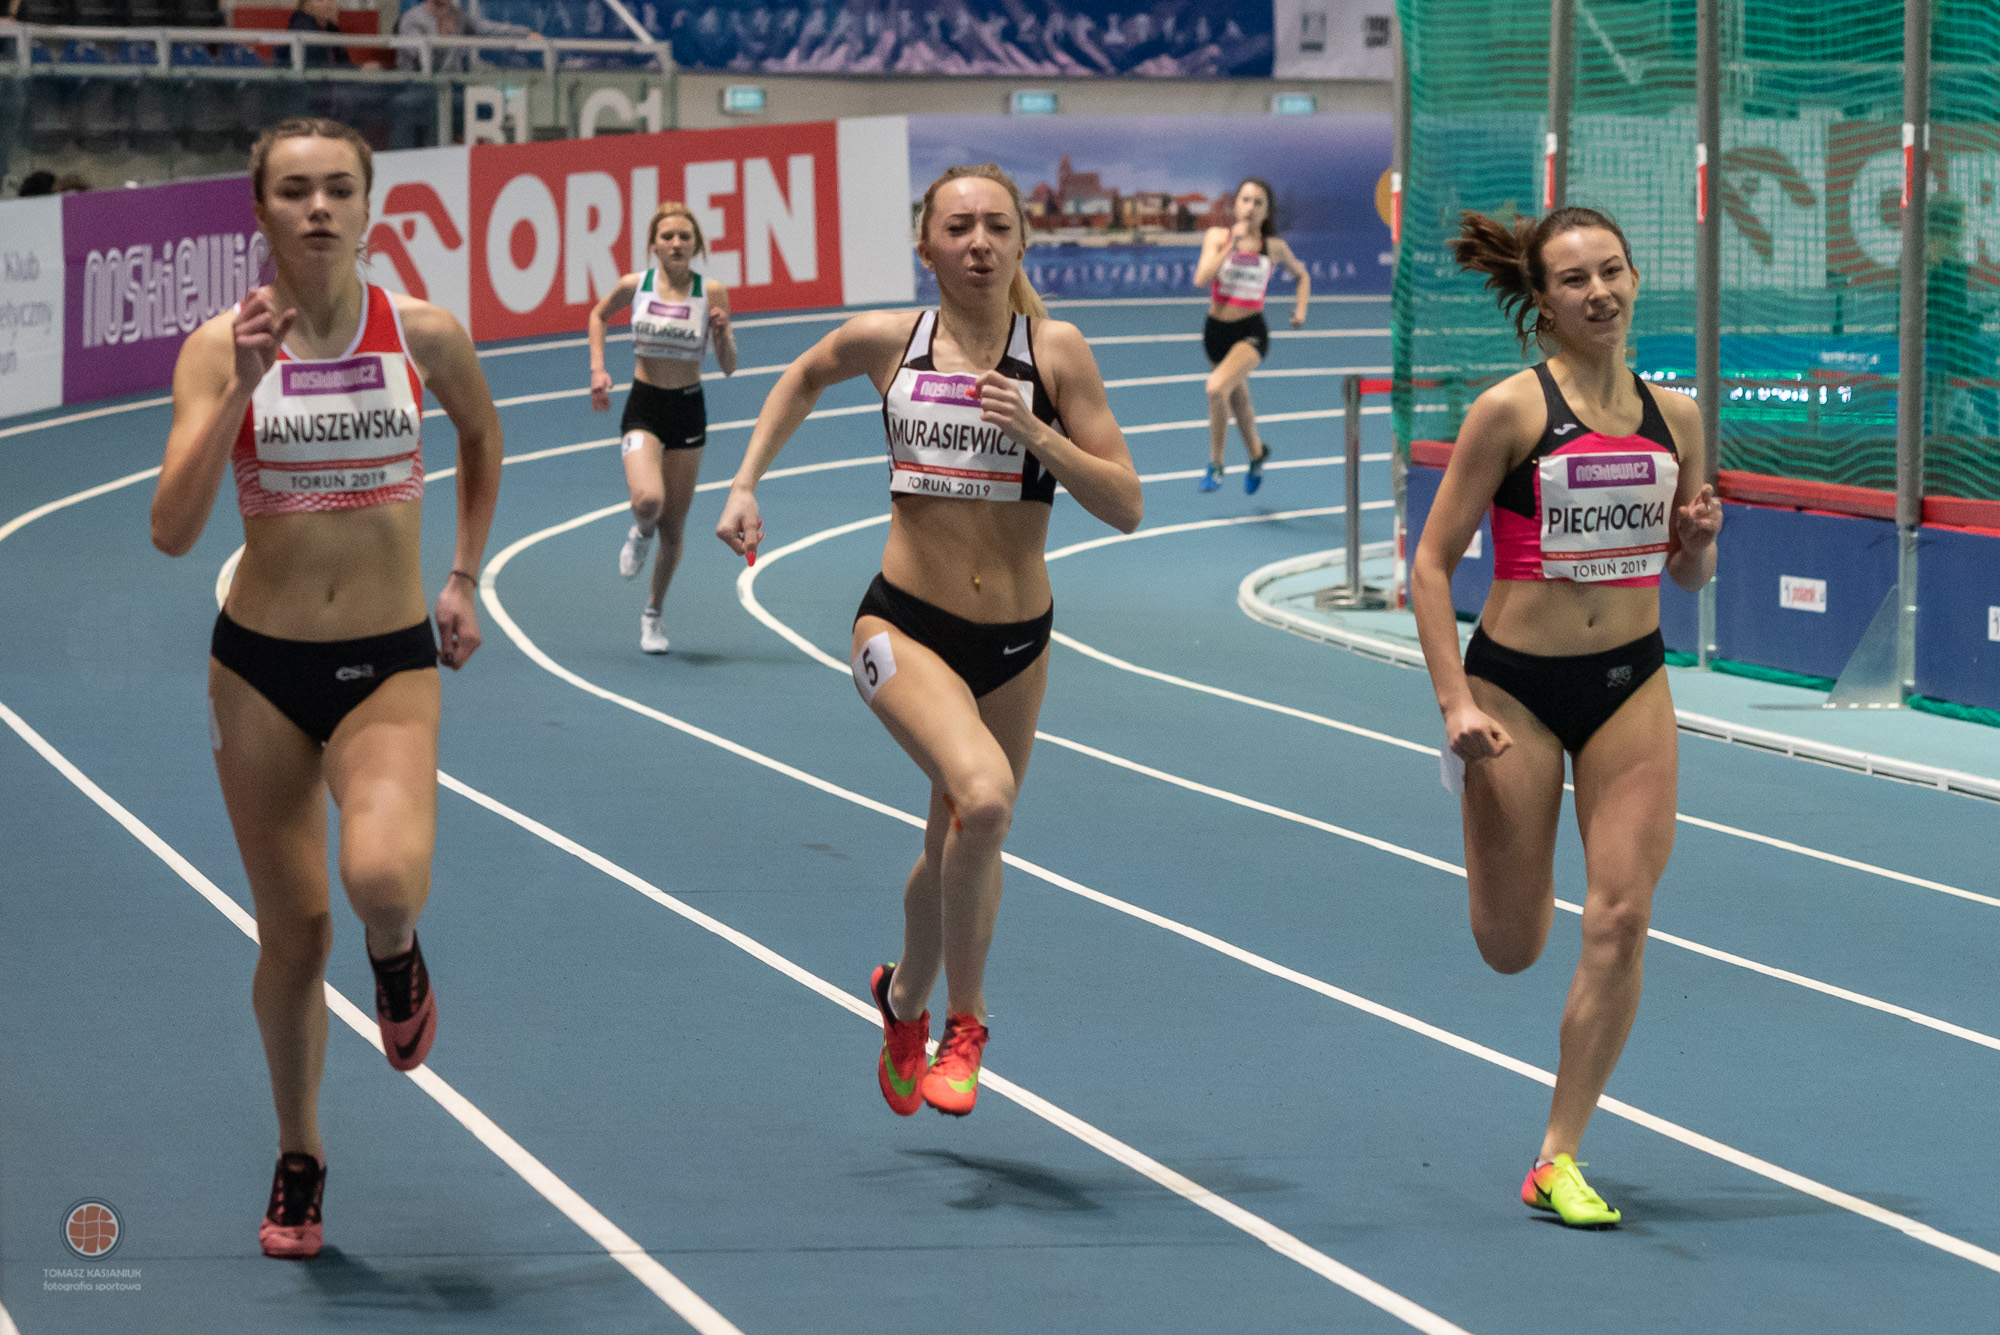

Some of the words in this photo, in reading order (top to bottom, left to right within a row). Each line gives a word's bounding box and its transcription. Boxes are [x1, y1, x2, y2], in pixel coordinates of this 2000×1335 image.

[486, 154, 817, 313] ORLEN
[261, 408, 413, 444] JANUSZEWSKA
[892, 418, 1019, 456] MURASIEWICZ
[350, 469, 387, 487] 2019
[907, 476, 951, 493] TORUŃ
[957, 482, 991, 496] 2019
[1548, 501, 1664, 533] PIECHOCKA
[1573, 560, 1616, 578] TORUŃ
[1621, 560, 1647, 574] 2019
[863, 647, 878, 686] 5
